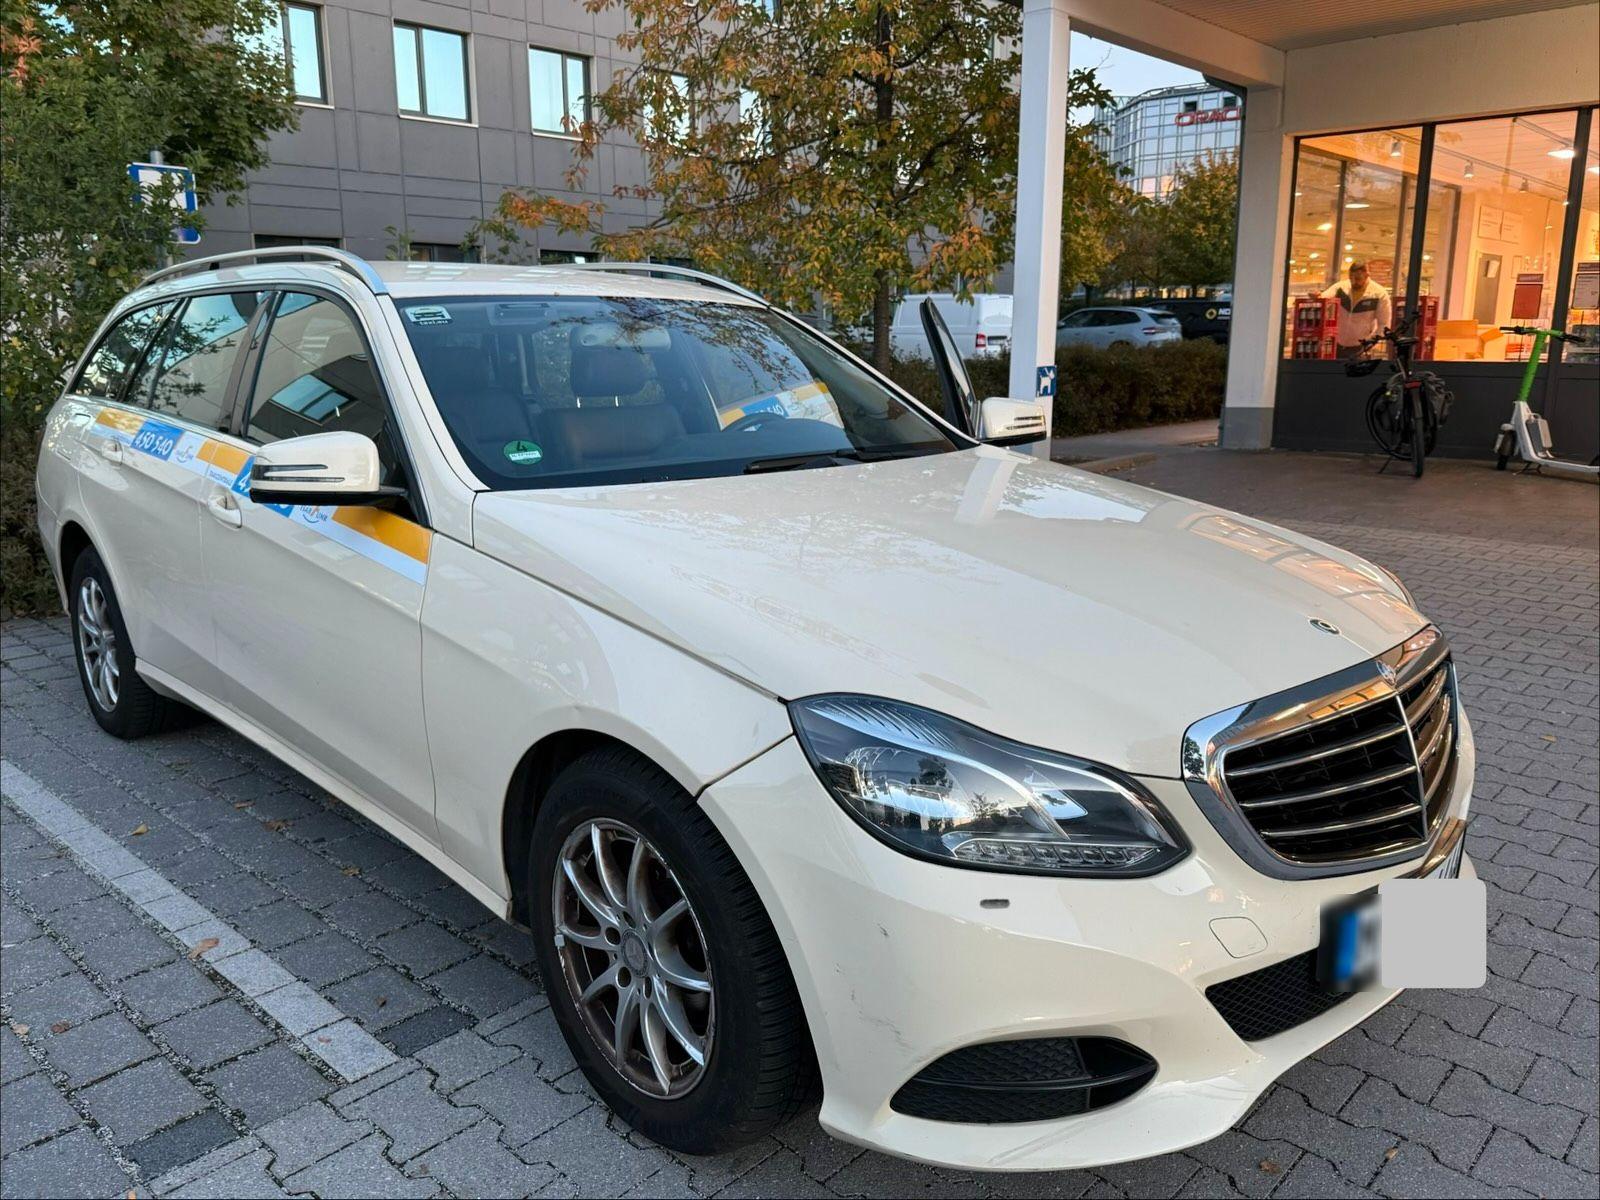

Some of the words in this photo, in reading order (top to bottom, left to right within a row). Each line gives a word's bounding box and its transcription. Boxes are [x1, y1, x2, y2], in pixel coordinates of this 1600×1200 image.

[134, 430, 154, 449] 450
[152, 435, 173, 456] 540
[516, 441, 528, 452] 4
